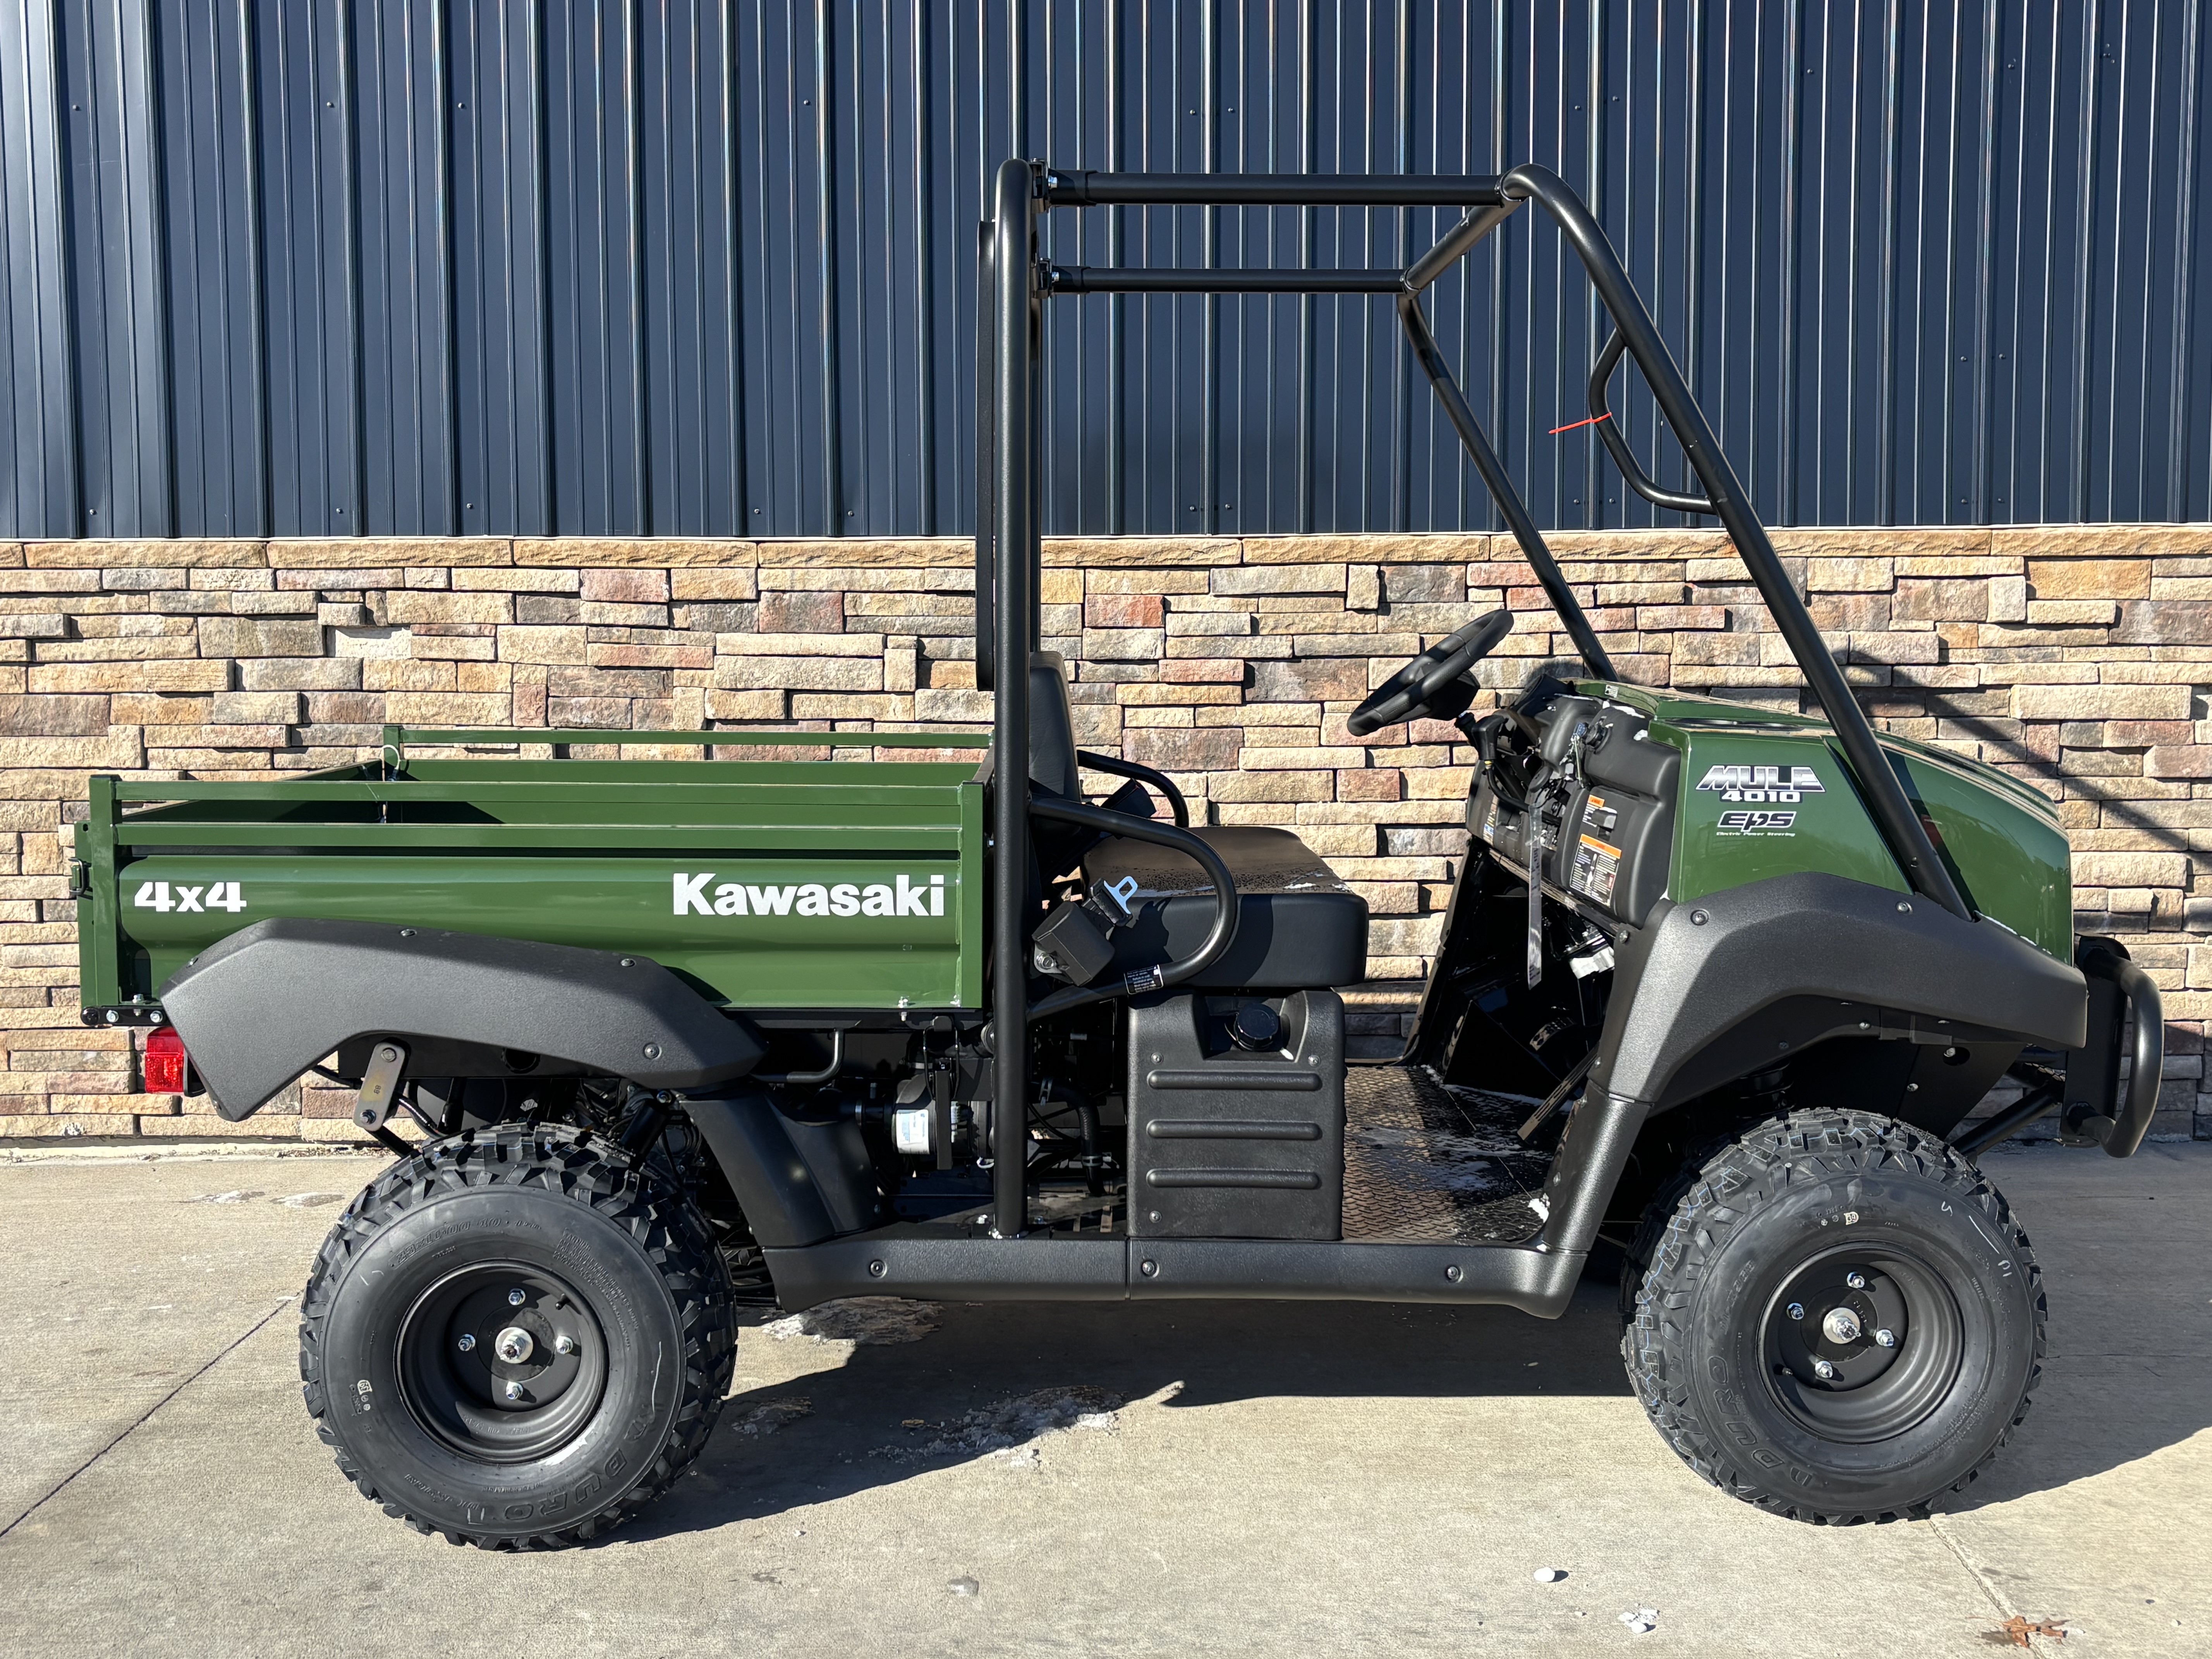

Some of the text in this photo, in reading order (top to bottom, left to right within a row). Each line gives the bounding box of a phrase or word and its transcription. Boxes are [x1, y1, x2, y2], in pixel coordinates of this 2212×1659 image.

[1695, 765, 1826, 792] MULE
[1721, 791, 1800, 802] 4010
[134, 881, 247, 912] 4x4
[673, 873, 944, 917] Kawasaki
[1707, 1356, 1784, 1469] DURO
[505, 1448, 628, 1521] DURO
